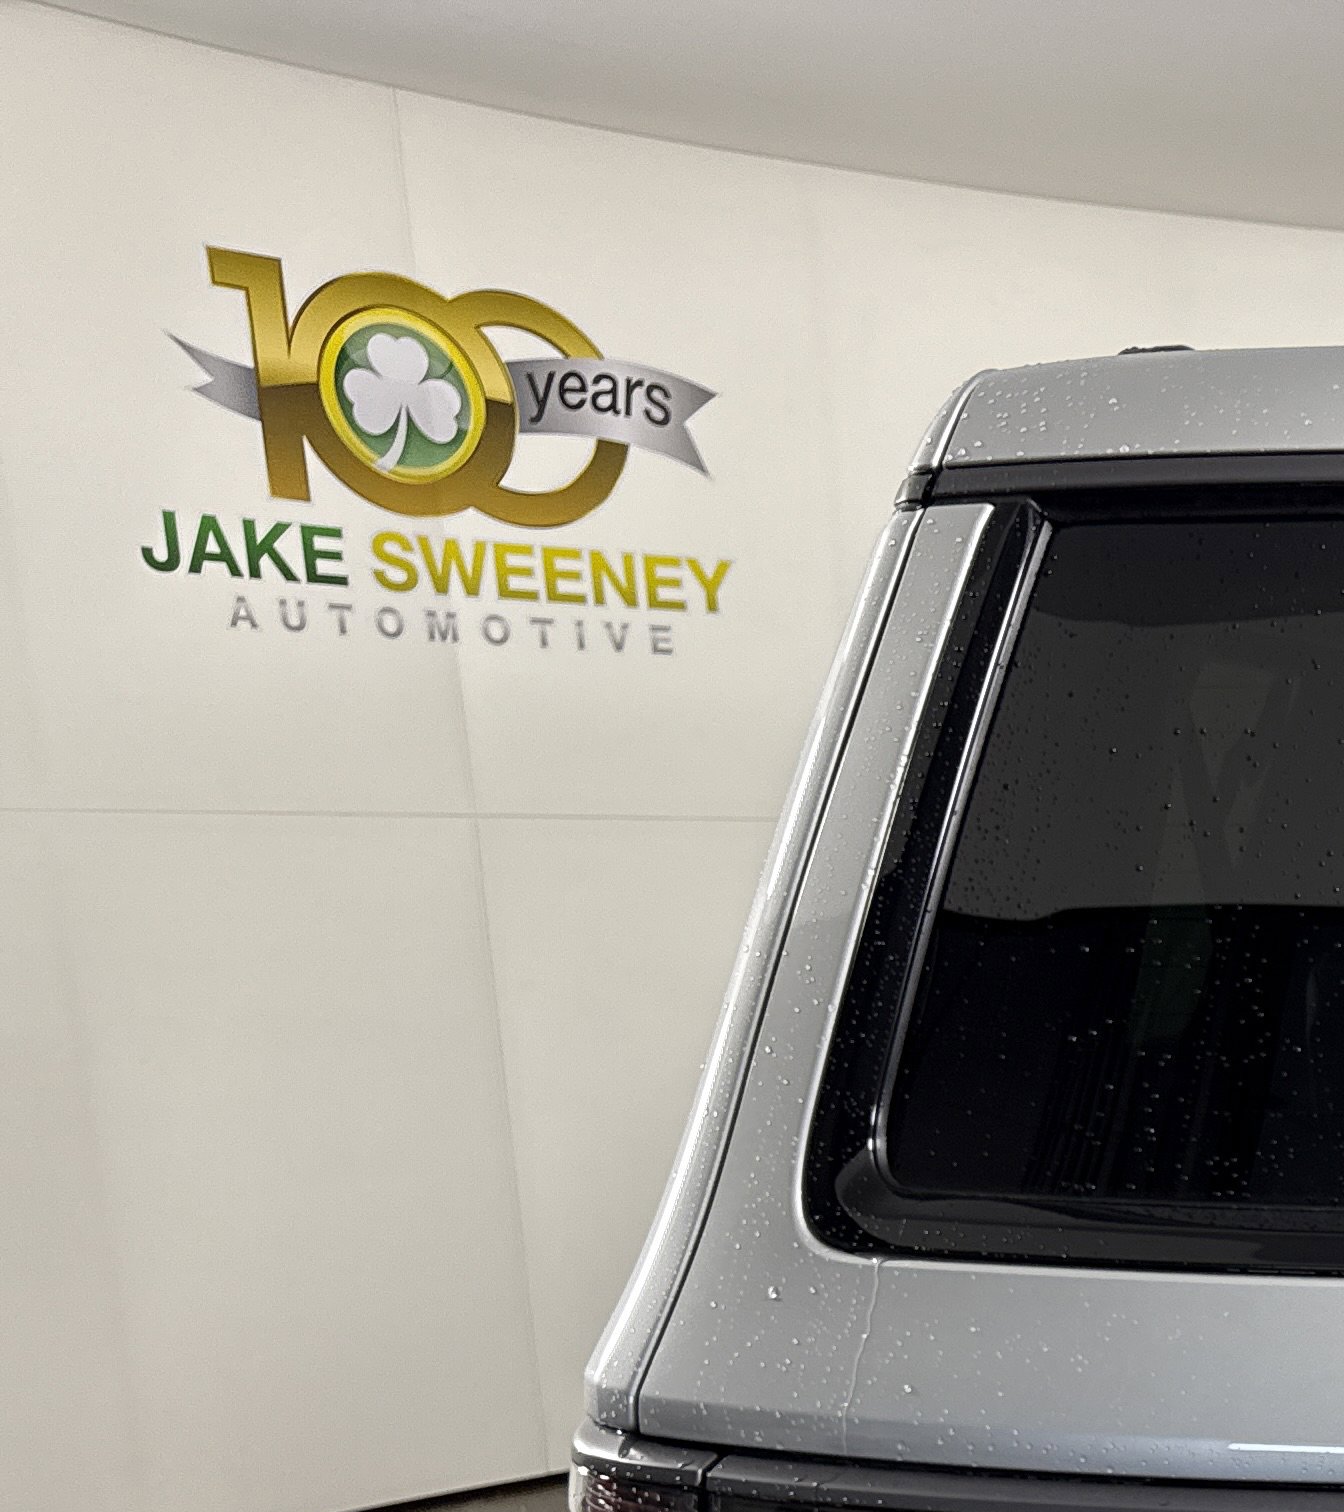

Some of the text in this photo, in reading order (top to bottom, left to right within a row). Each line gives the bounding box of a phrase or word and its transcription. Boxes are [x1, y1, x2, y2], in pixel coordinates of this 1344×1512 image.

[206, 245, 672, 528] 100 years
[141, 510, 733, 612] JAKE SWEENEY
[229, 597, 675, 656] AUTOMOTIVE
